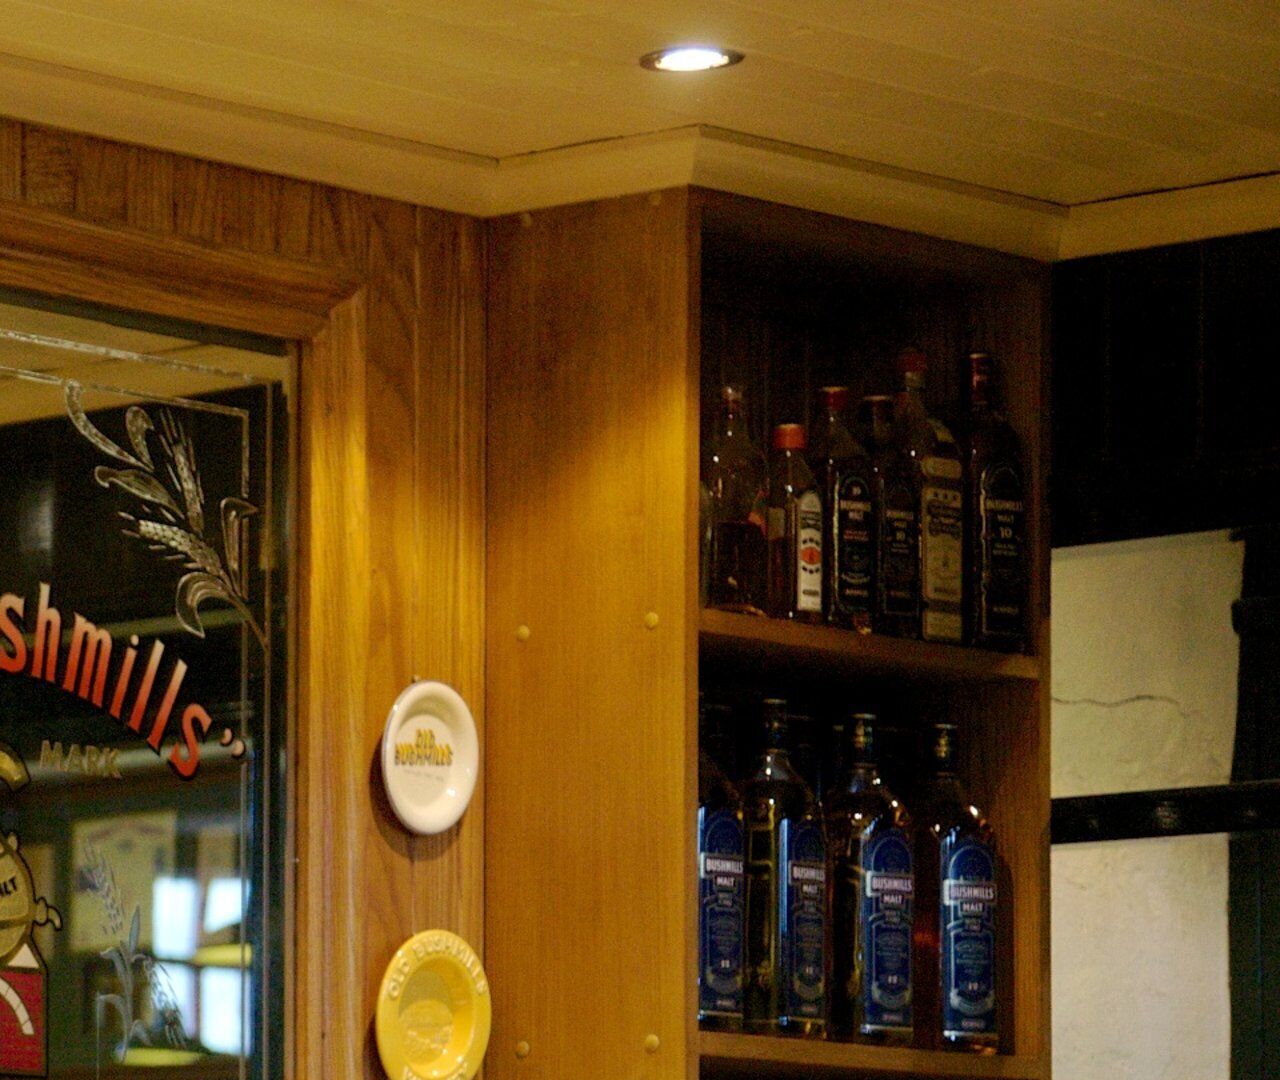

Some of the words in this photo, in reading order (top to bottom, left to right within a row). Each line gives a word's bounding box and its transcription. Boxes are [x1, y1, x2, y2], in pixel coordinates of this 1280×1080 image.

[999, 526, 1013, 539] 10
[415, 727, 437, 750] OLD
[40, 740, 122, 780] MARK
[383, 744, 455, 768] BUSHMILLS
[705, 858, 744, 875] BUSHMILLS
[715, 876, 736, 888] MALT
[801, 884, 819, 895] MALT
[871, 876, 914, 892] BUSHMILLS
[882, 894, 903, 905] MALT
[950, 884, 995, 901] BUSHMILLS
[962, 902, 985, 914] MALT
[413, 936, 490, 999] BUSHMILLS
